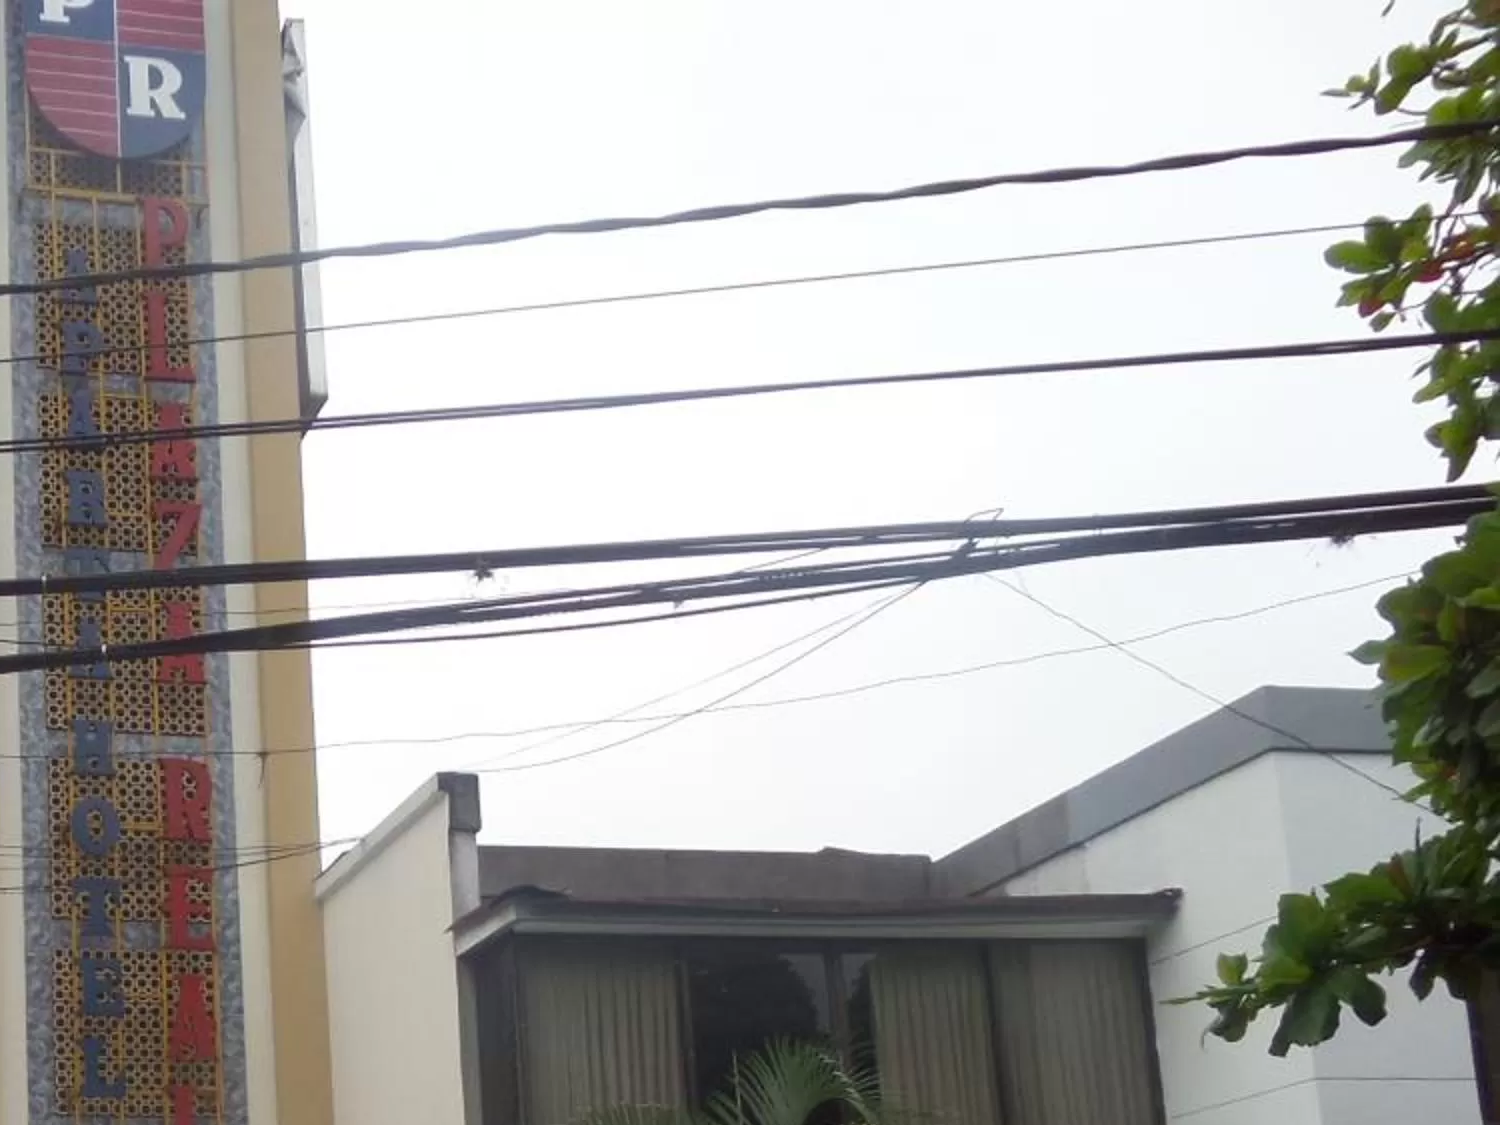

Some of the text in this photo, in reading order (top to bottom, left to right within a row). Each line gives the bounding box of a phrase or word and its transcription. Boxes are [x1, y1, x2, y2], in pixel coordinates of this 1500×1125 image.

[123, 54, 187, 121] R
[141, 195, 208, 684] PLAZA
[70, 717, 128, 1099] HOTEL
